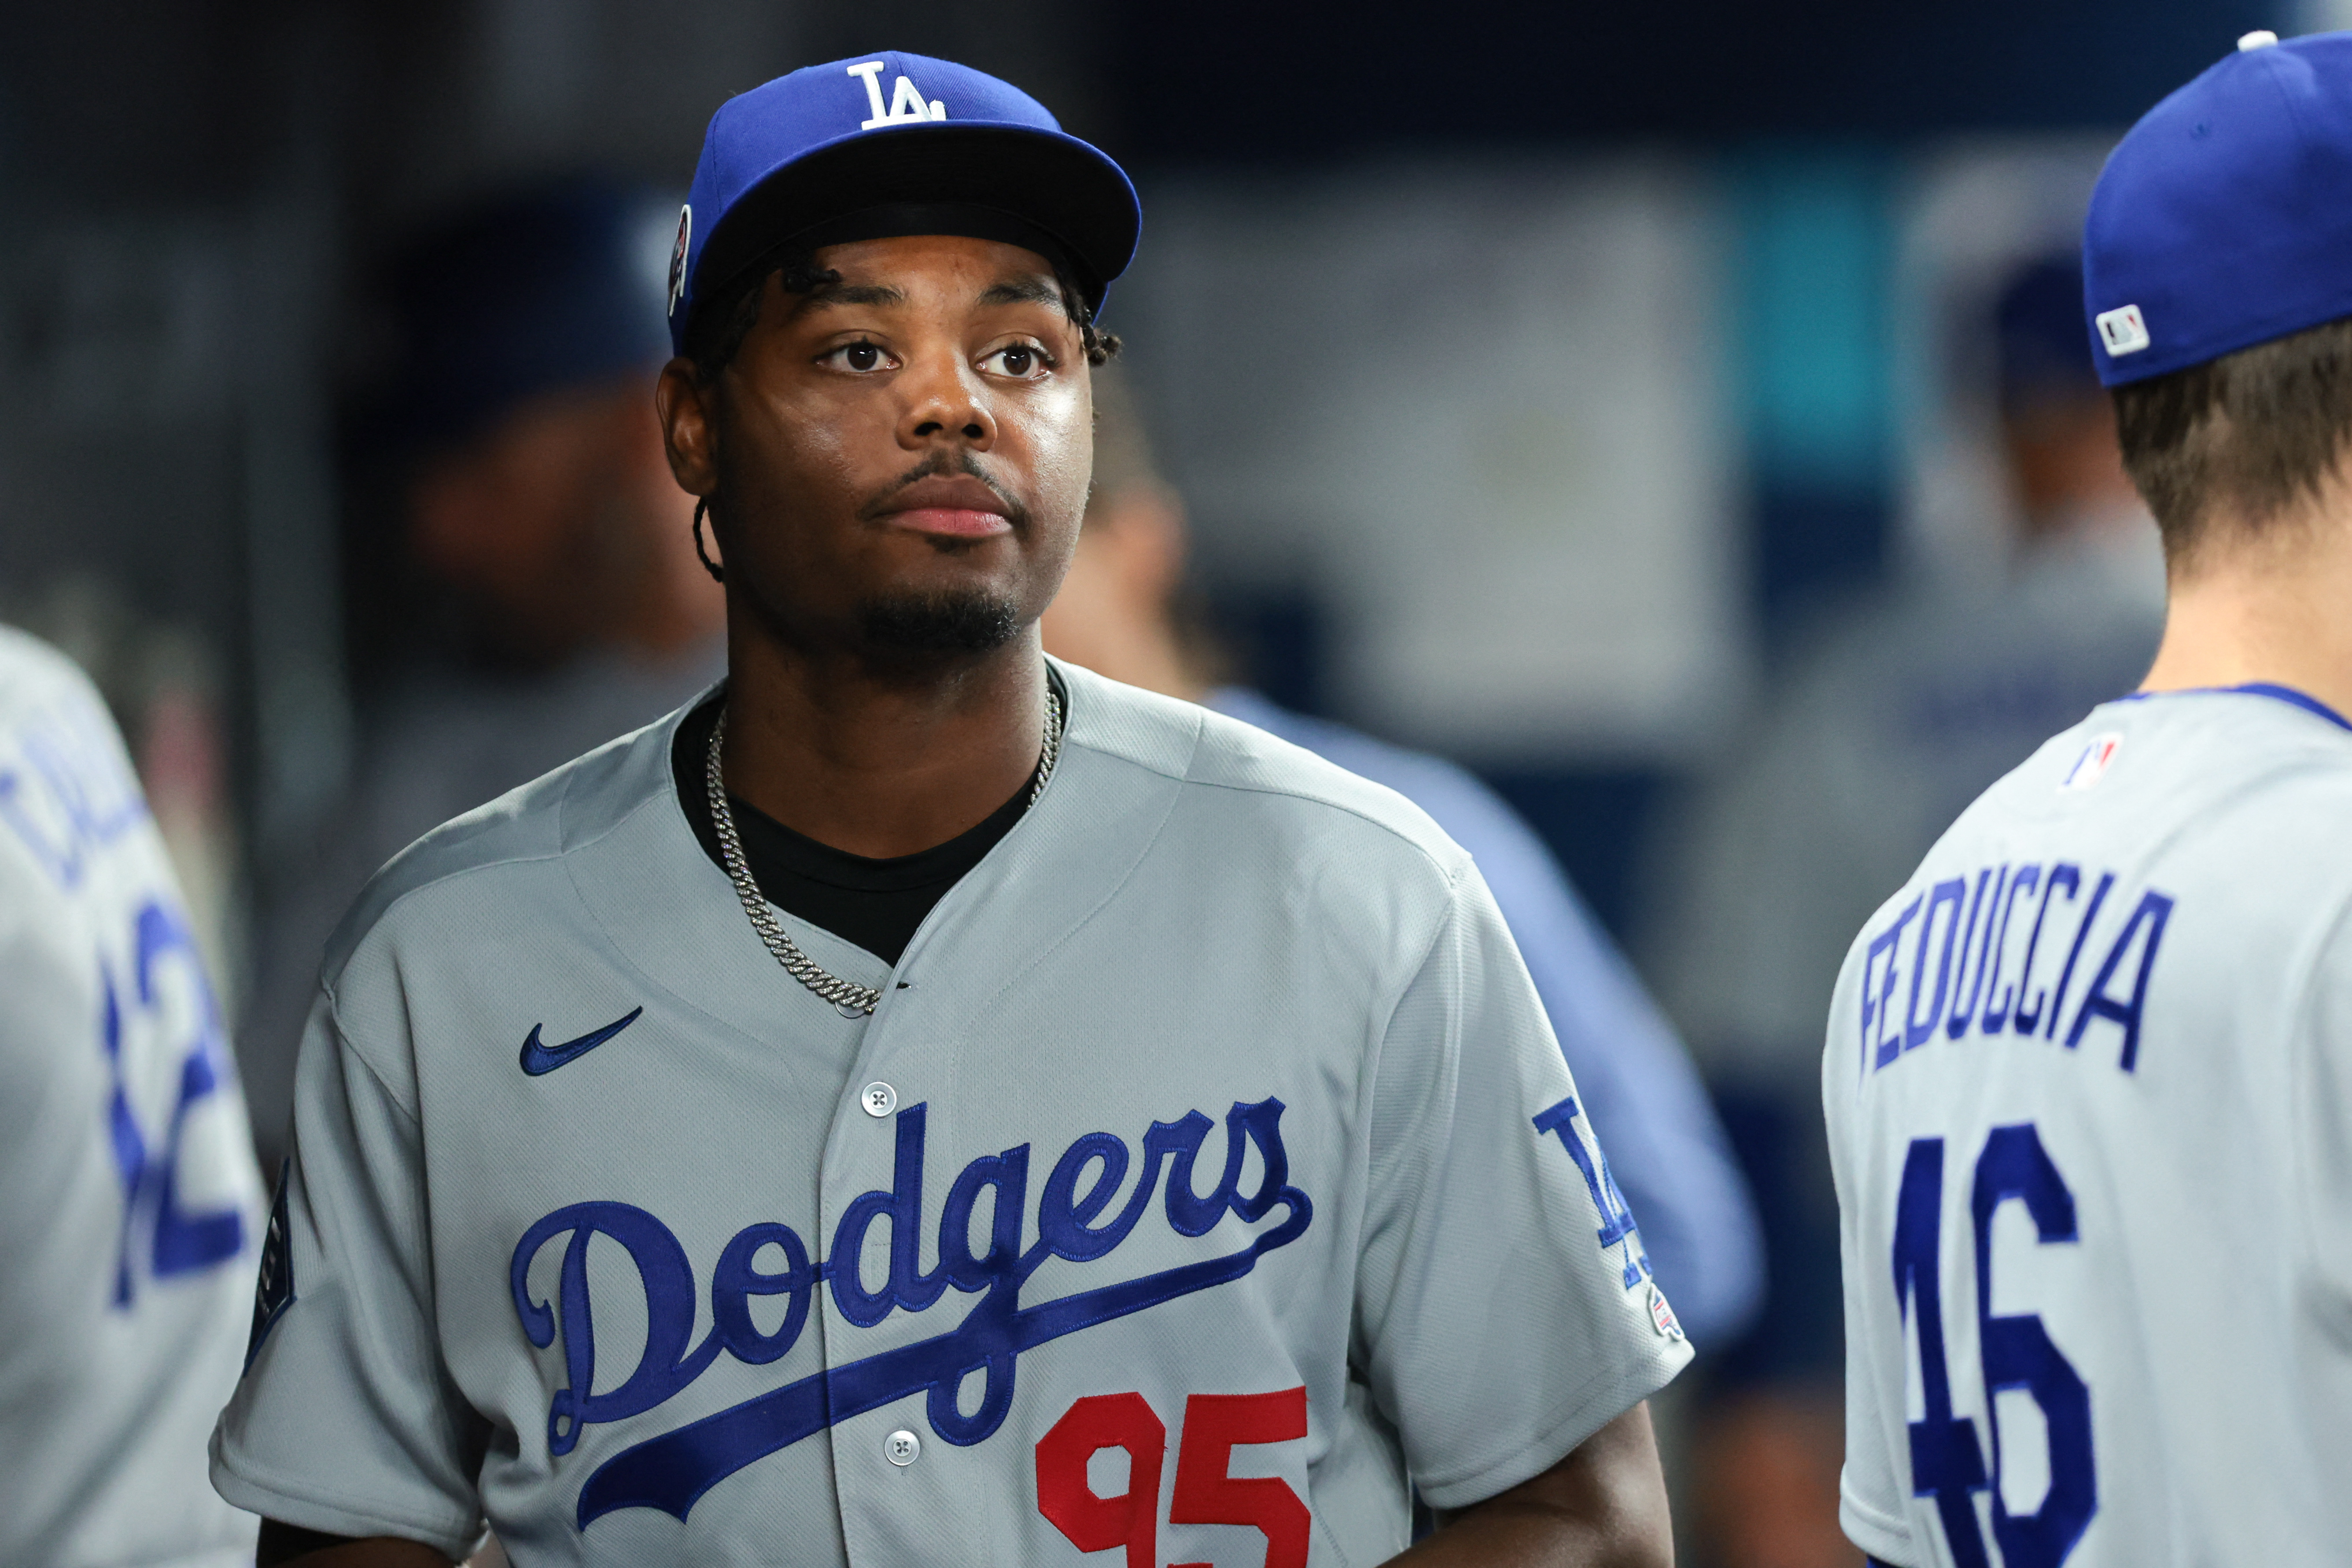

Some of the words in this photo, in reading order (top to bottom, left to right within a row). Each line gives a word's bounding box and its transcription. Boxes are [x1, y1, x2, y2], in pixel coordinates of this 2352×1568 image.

[847, 60, 947, 130] LA
[1857, 861, 2174, 1094] FEDUCCIA
[510, 1096, 1290, 1456] Dodgers
[1891, 1122, 2098, 1568] 46
[1035, 1385, 1311, 1568] 95
